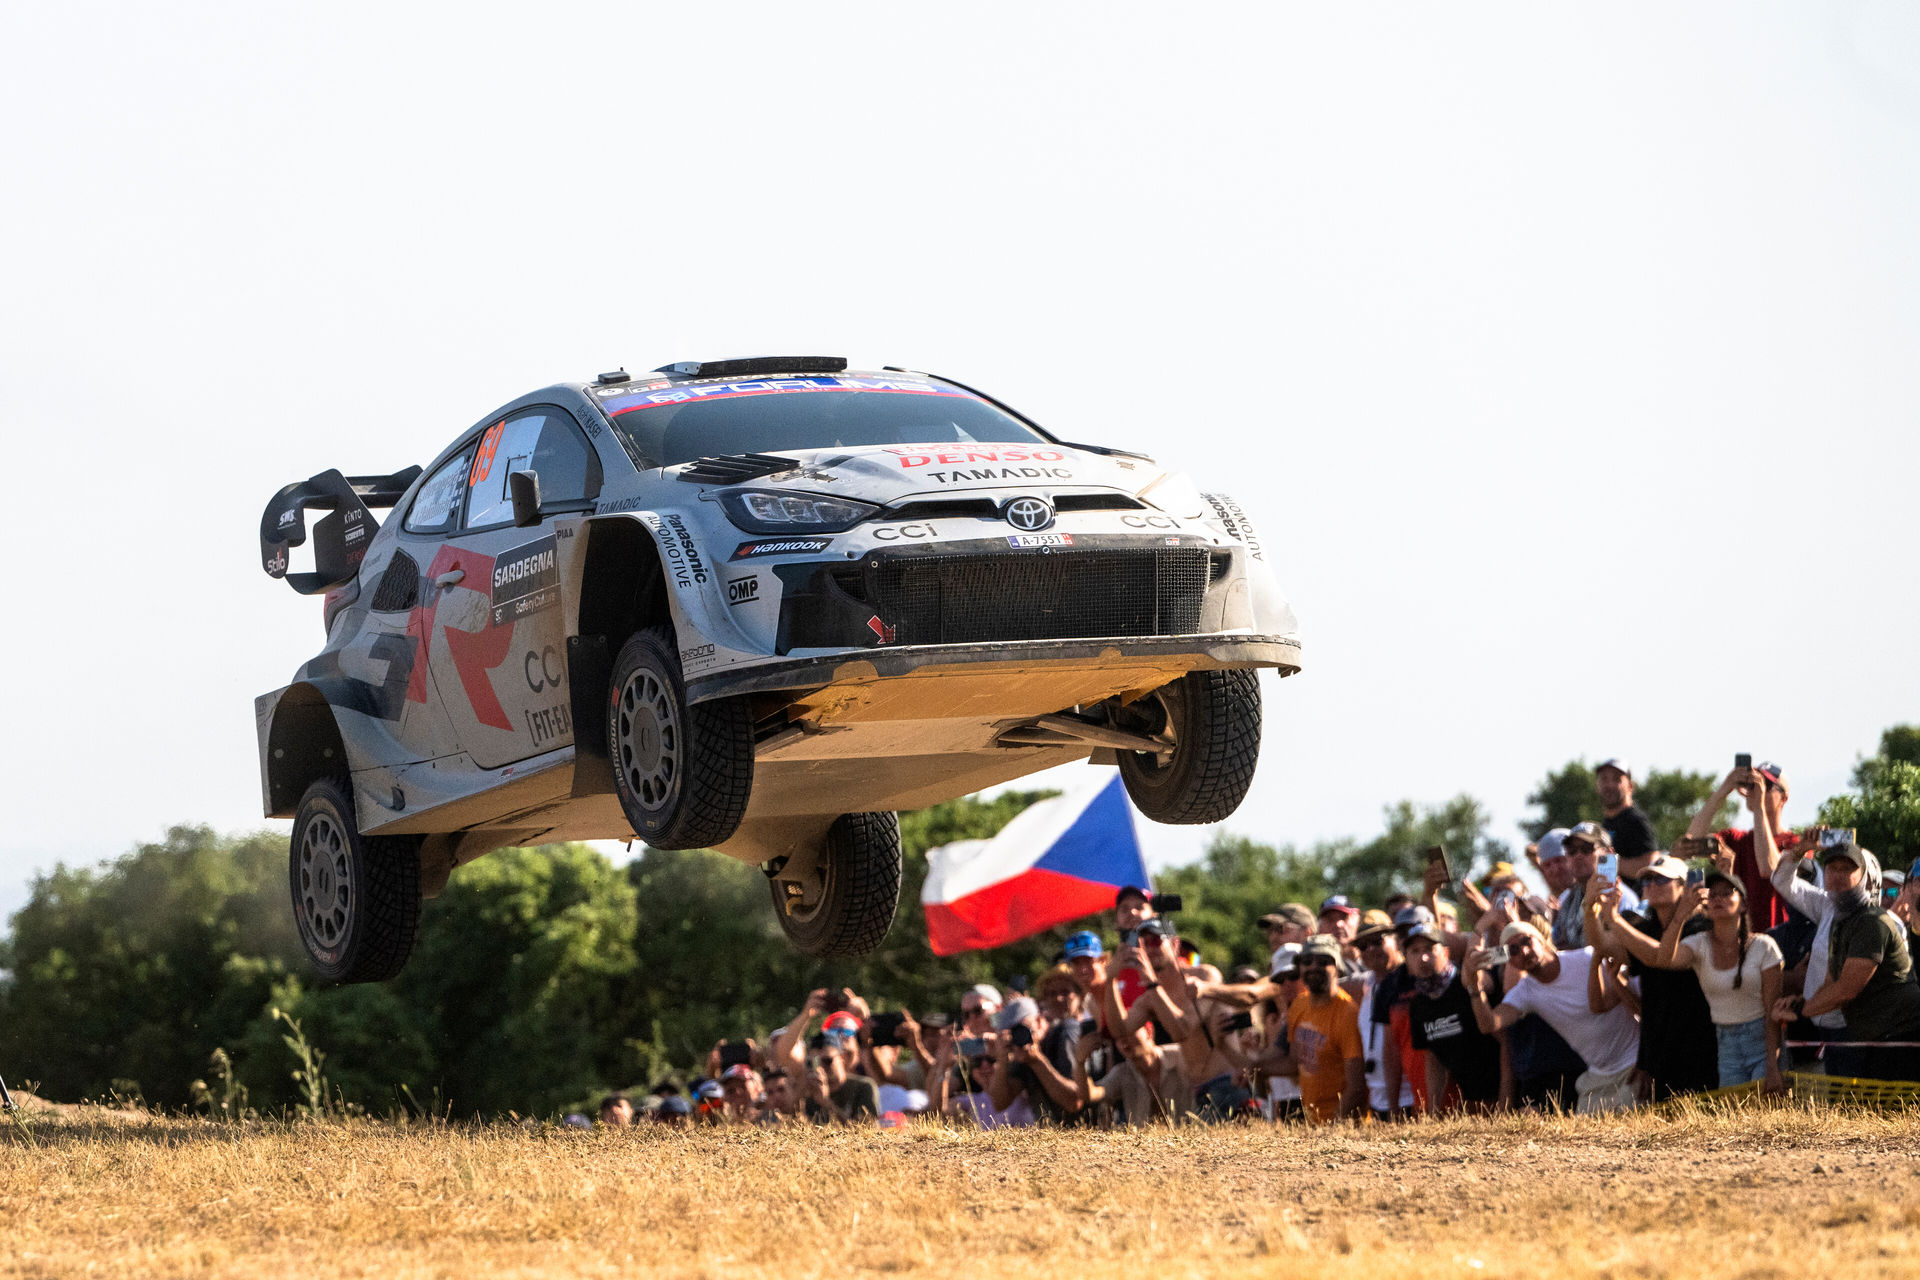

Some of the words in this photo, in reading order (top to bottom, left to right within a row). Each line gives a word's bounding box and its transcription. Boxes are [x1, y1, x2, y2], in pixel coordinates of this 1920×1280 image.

[469, 420, 505, 487] 69
[899, 451, 1064, 468] DENSO
[927, 467, 1073, 483] TAMADIC
[599, 496, 641, 513] TAMADIC
[663, 513, 709, 584] Panasonic
[1022, 535, 1061, 546] A-7551
[645, 516, 692, 589] AUTOMOTIVE
[494, 549, 554, 588] SARDEGNA
[729, 579, 759, 601] OMP
